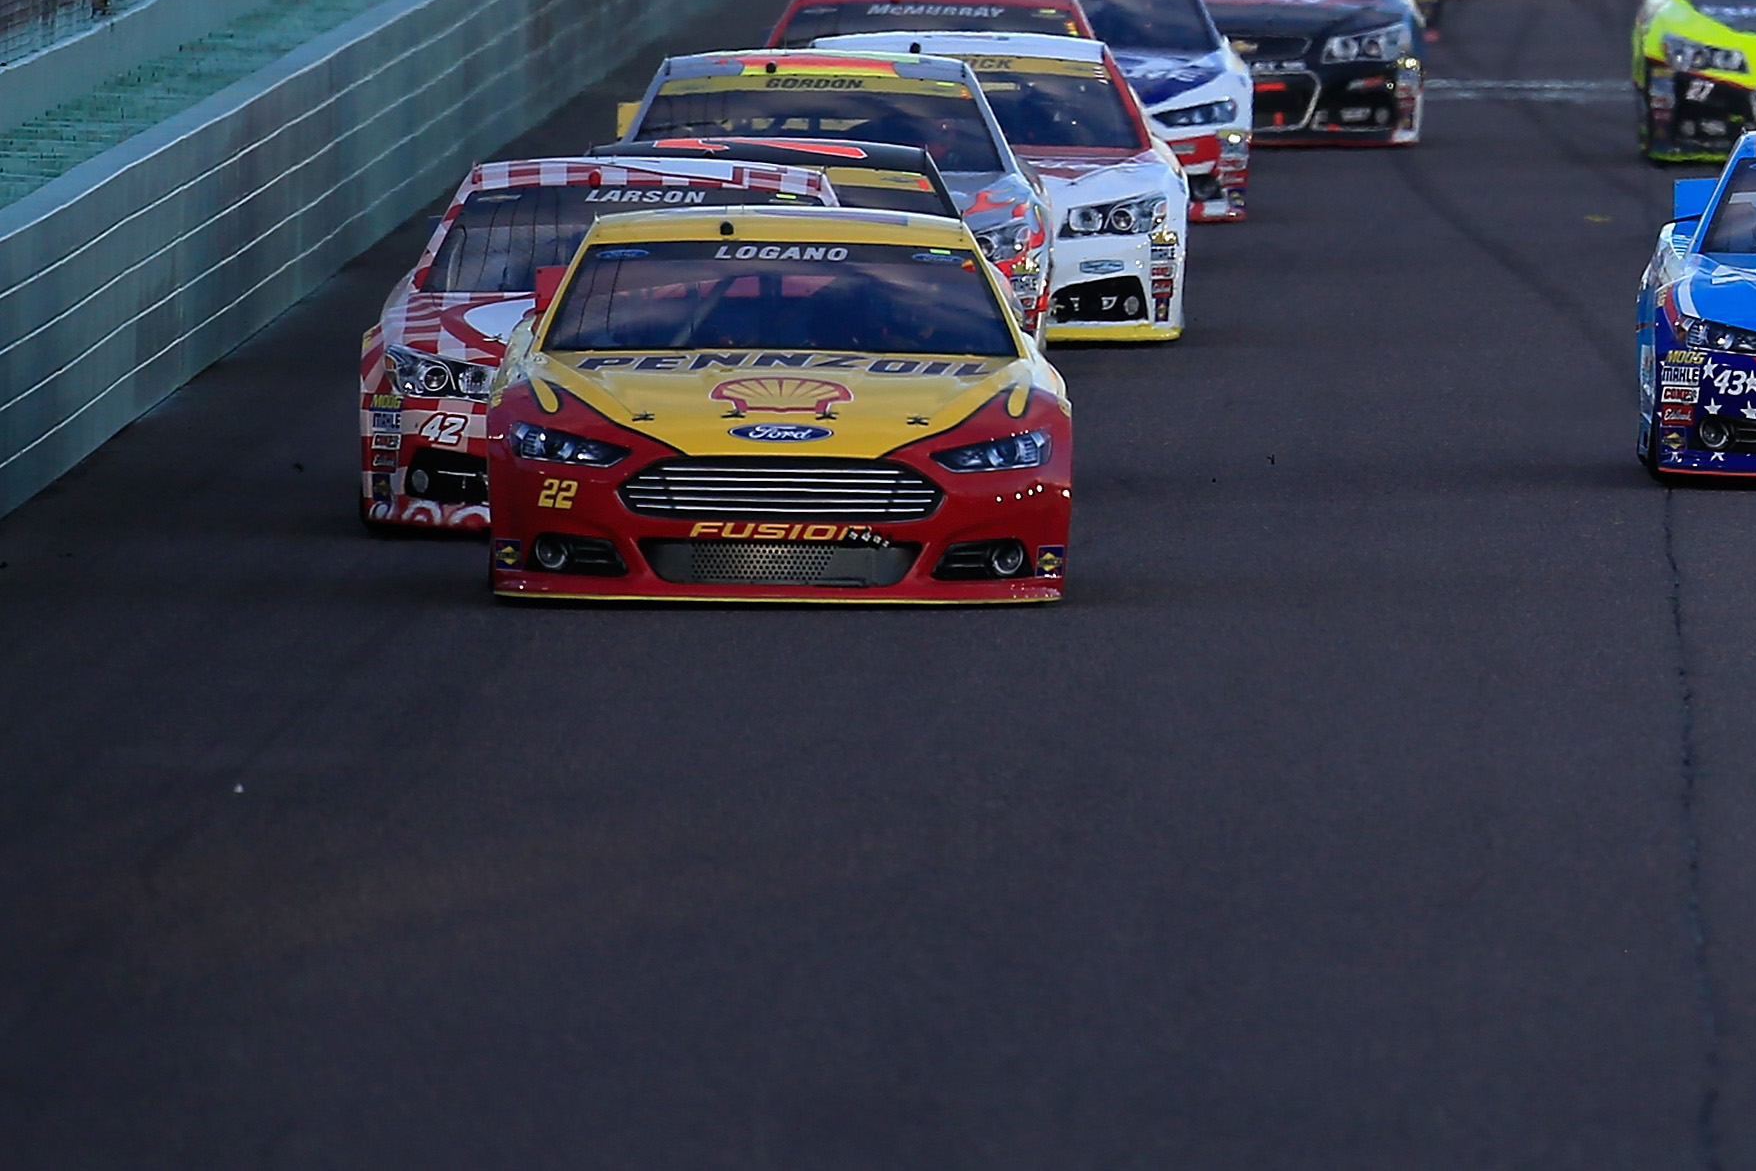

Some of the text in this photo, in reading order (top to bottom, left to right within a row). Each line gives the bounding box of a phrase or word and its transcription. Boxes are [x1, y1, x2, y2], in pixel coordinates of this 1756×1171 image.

[766, 78, 864, 90] GORDON
[585, 189, 706, 204] LARSON
[714, 245, 849, 262] LOGANO
[575, 351, 1000, 377] PENNZOIL
[1666, 350, 1708, 364] MOOG
[1662, 367, 1700, 383] MAHLE
[1713, 369, 1748, 396] 43
[420, 414, 467, 446] 42
[747, 425, 814, 441] Ford
[537, 478, 579, 510] 22
